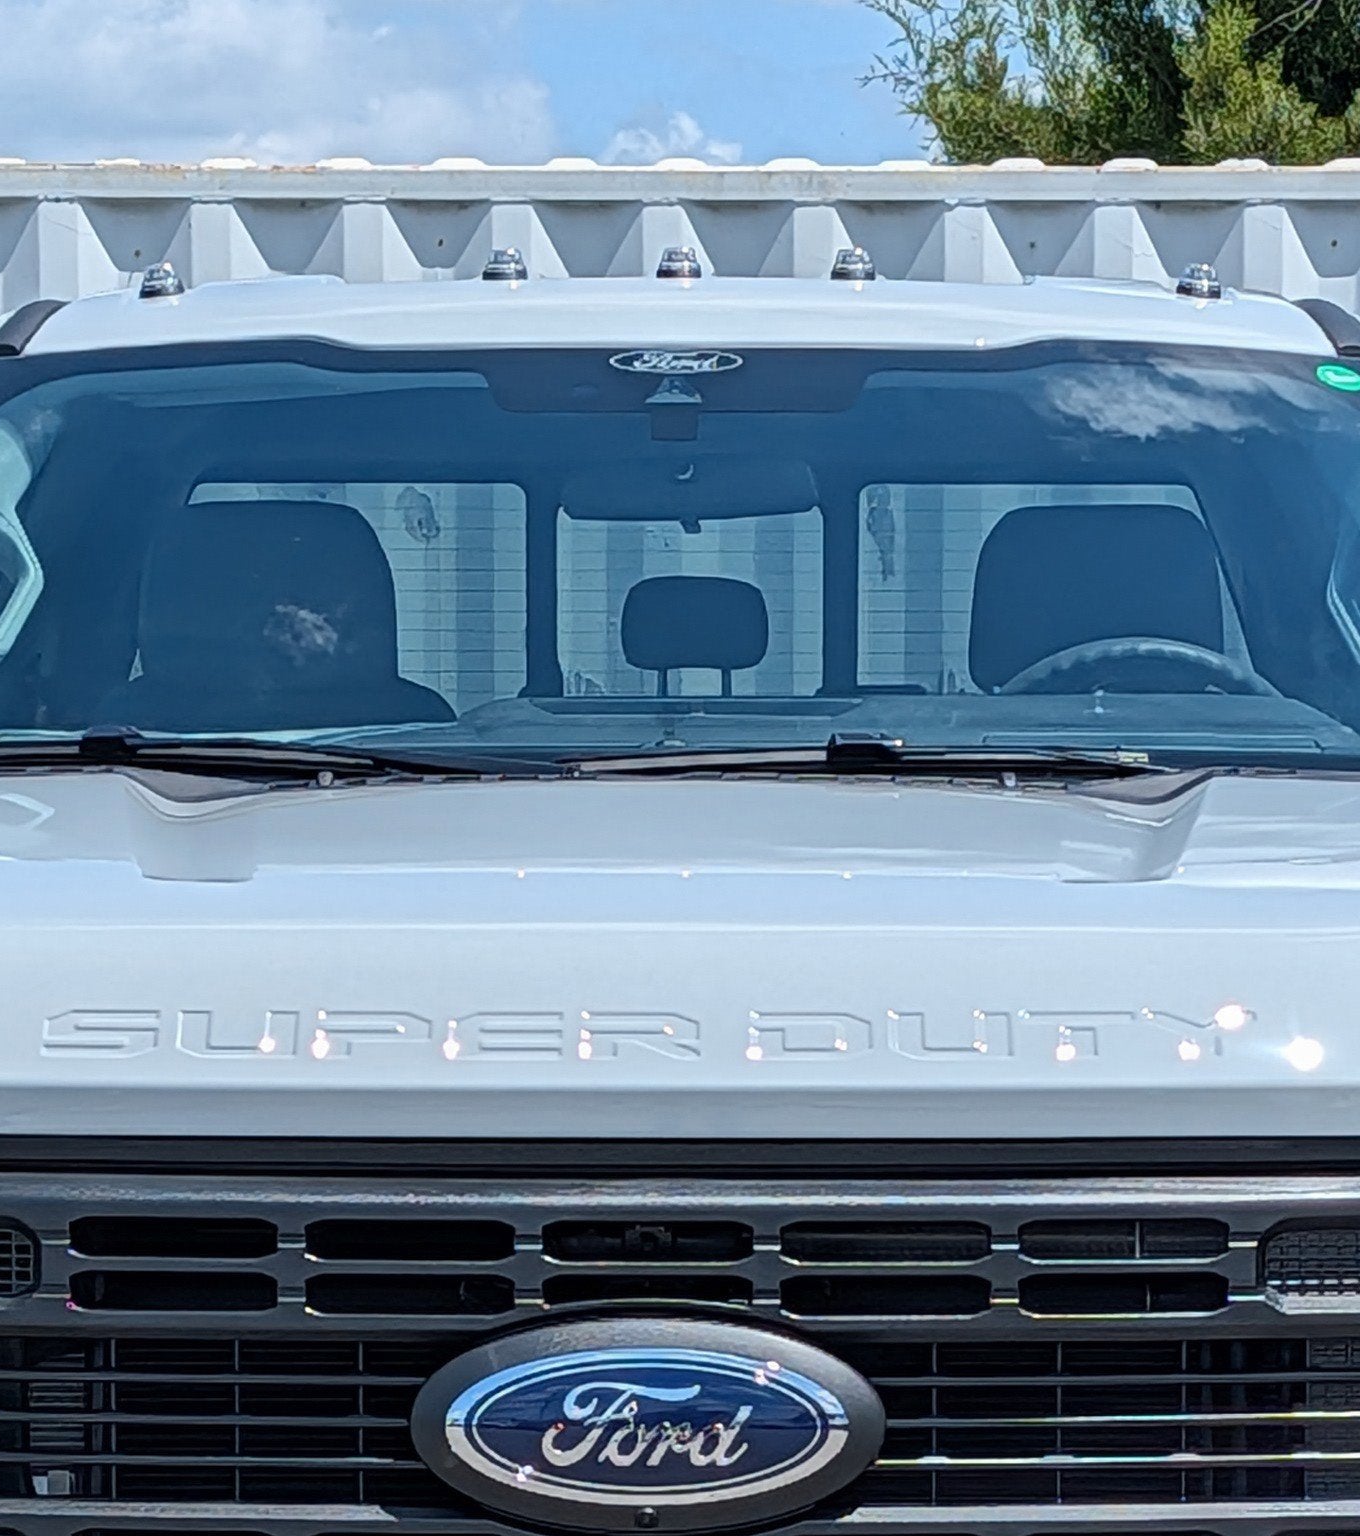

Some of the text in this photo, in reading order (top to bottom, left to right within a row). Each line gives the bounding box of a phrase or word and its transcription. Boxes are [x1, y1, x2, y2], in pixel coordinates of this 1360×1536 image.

[39, 1007, 1258, 1061] SUPER DUTY
[541, 1381, 754, 1467] Ford
